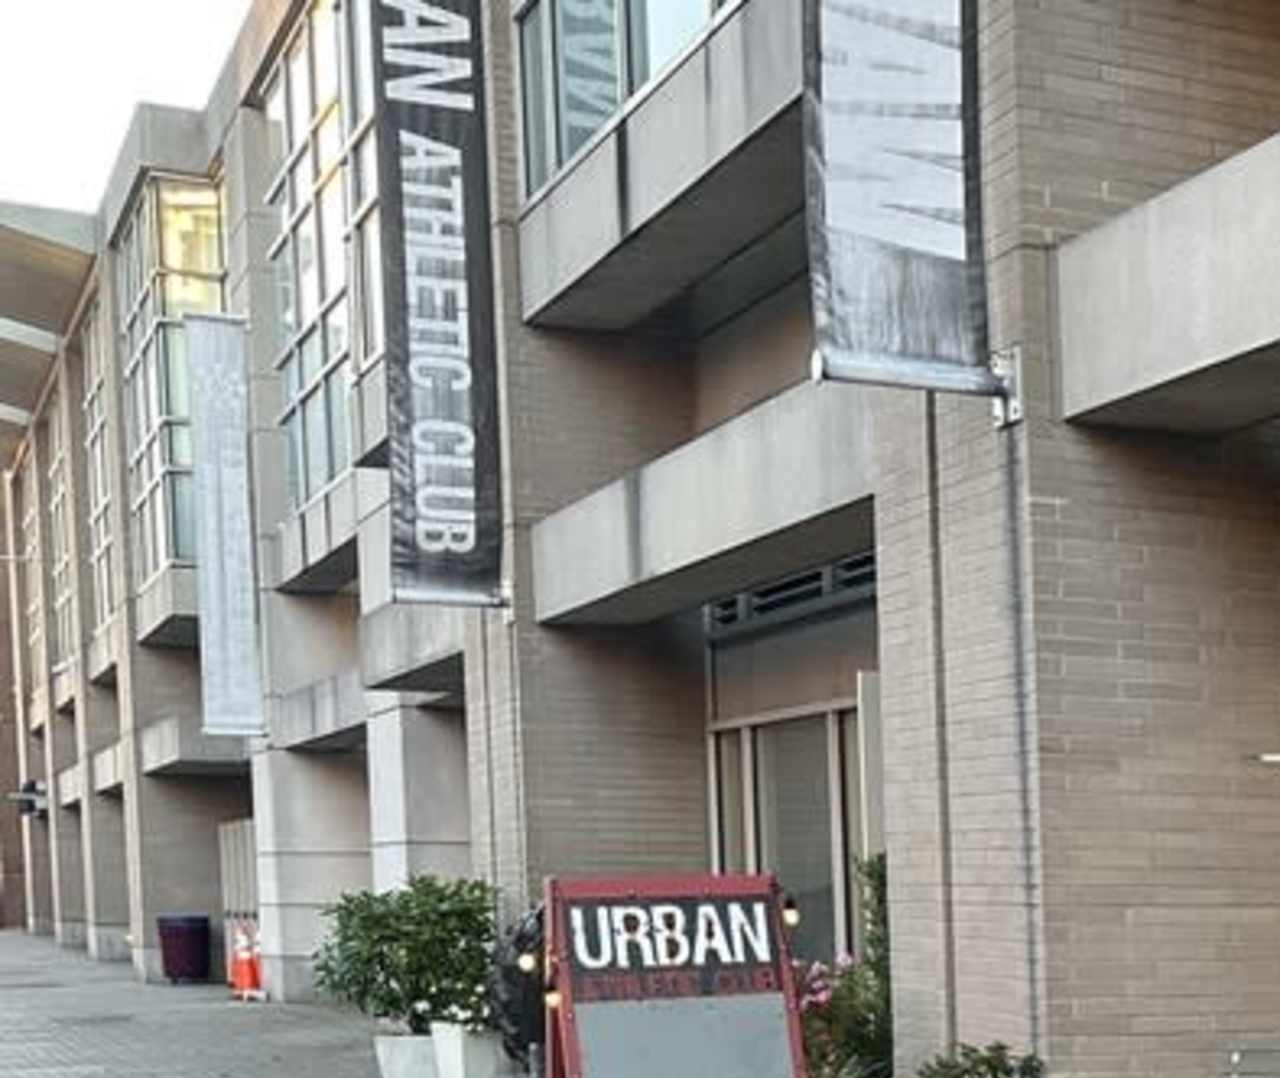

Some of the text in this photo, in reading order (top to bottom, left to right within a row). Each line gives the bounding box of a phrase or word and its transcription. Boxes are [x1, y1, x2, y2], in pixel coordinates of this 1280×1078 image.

[399, 129, 472, 391] ATHLETIC
[411, 421, 476, 554] CLUB
[570, 902, 772, 970] URBAN
